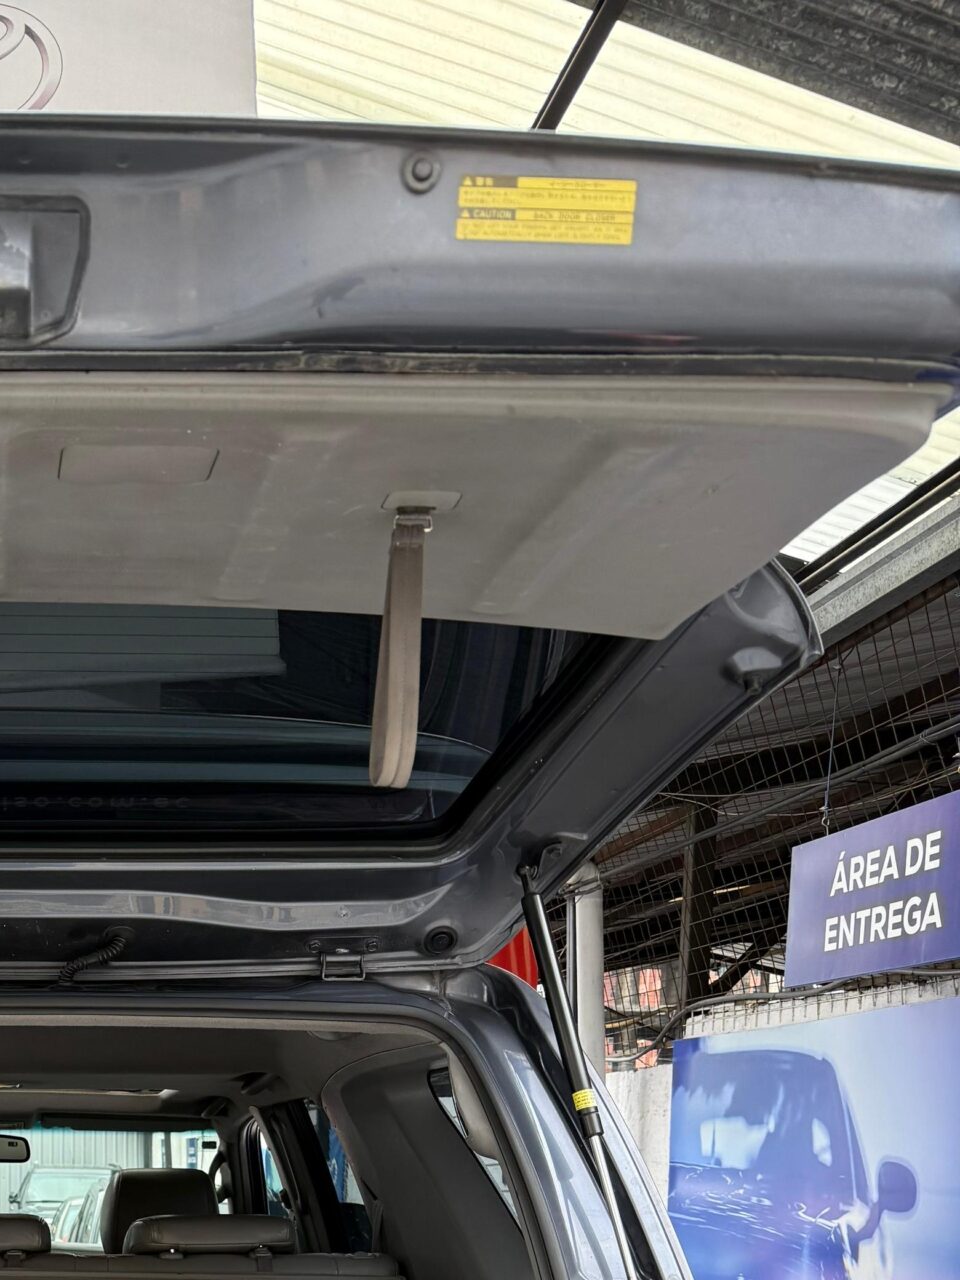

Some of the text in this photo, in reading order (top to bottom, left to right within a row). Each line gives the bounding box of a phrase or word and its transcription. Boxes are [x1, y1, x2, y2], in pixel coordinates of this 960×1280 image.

[473, 209, 512, 219] CAUTION
[830, 830, 942, 897] ÁREA DE
[824, 892, 942, 952] ENTREGA
